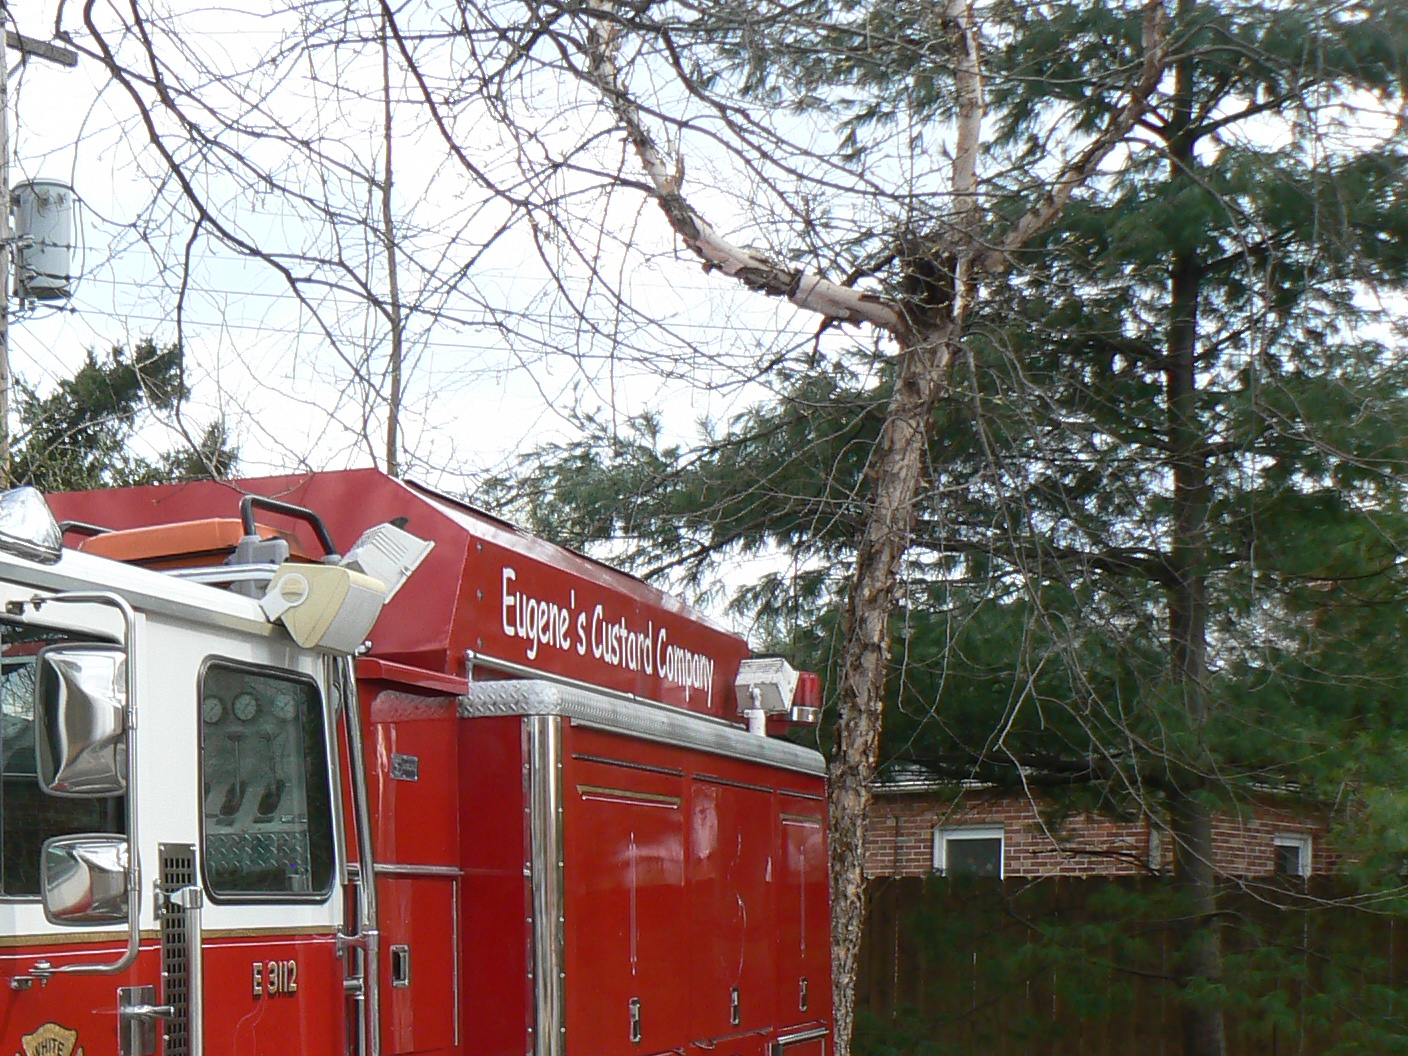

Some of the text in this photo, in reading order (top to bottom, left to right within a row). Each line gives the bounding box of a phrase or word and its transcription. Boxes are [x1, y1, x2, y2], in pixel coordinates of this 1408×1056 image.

[501, 566, 716, 708] Eugene's Custard Company
[252, 959, 298, 996] E 3112
